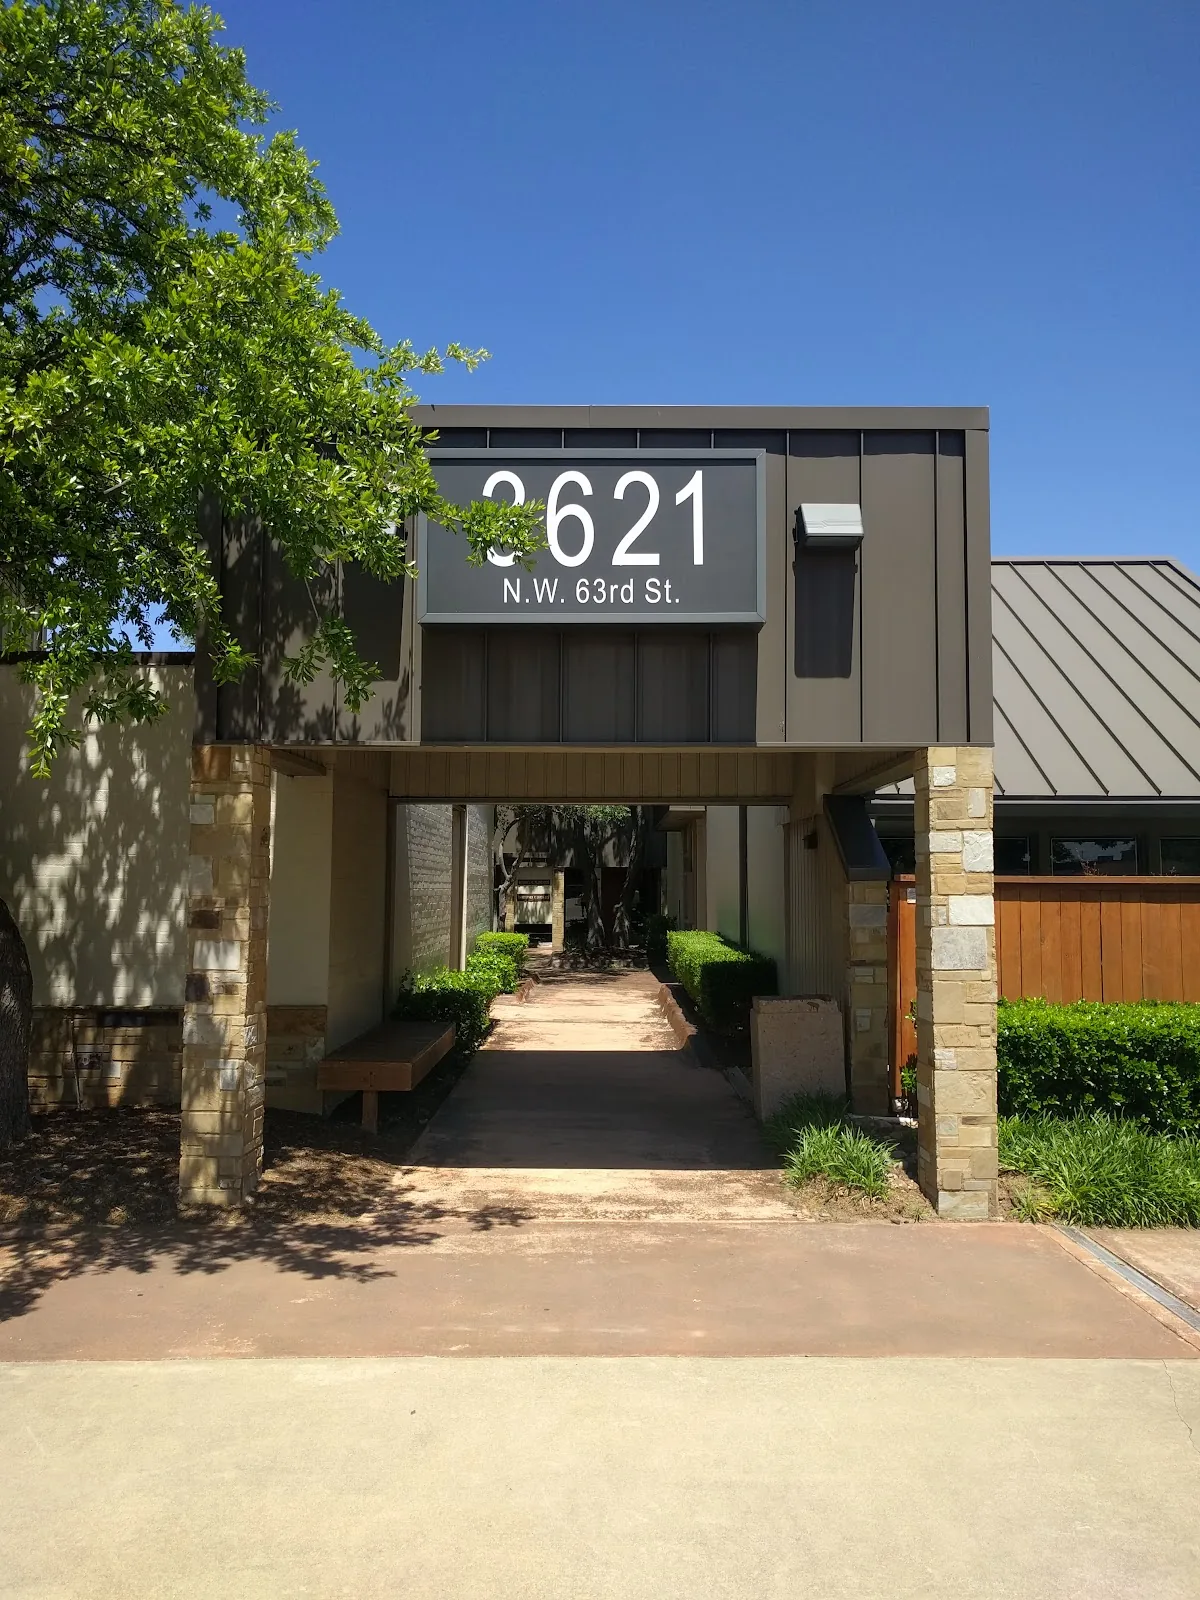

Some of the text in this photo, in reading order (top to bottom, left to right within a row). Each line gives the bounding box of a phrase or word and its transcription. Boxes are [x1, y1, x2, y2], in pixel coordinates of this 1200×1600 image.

[503, 577, 680, 604] N.W. 63rd St.
